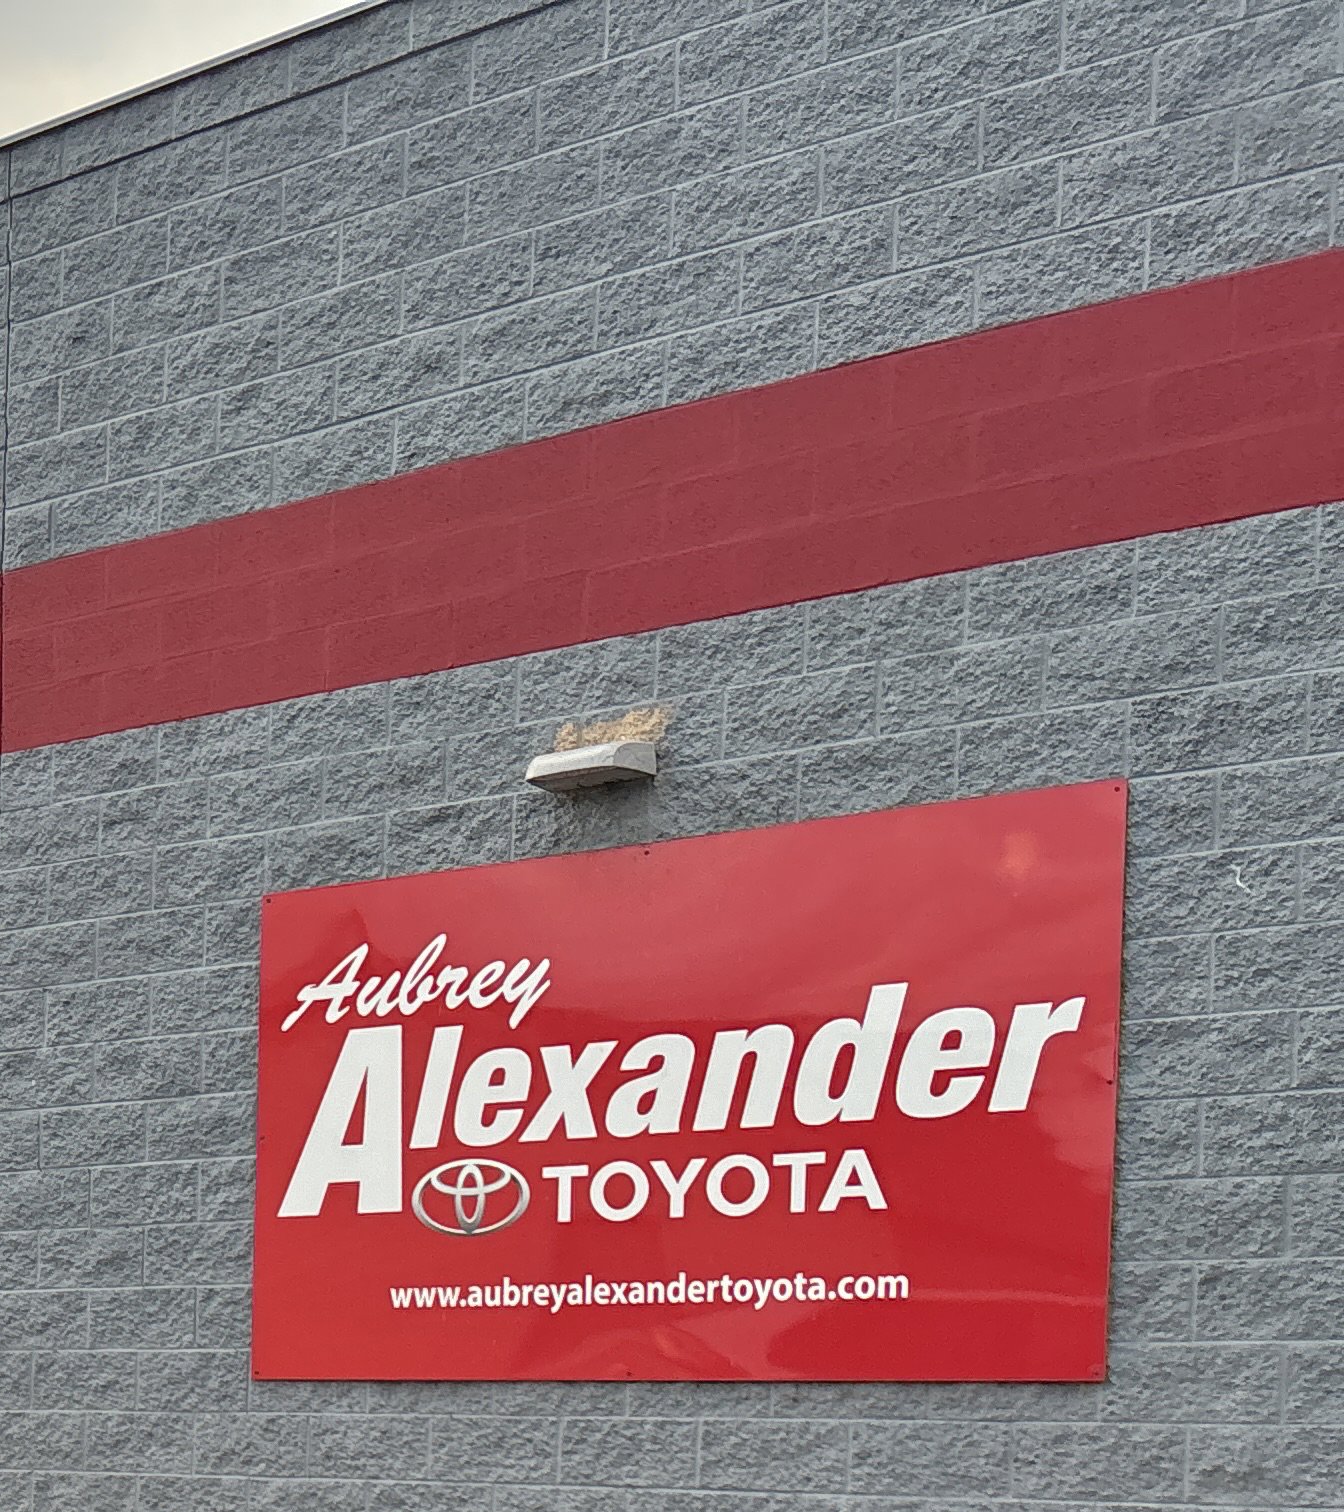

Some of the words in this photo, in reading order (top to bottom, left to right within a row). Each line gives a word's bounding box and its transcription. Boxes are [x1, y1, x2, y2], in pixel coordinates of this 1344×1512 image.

[280, 932, 552, 1032] Aubrey
[277, 981, 1086, 1218] Alexander
[541, 1149, 888, 1223] TOYOTA
[389, 1271, 909, 1314] www.aubreyalexandertoyota.com
